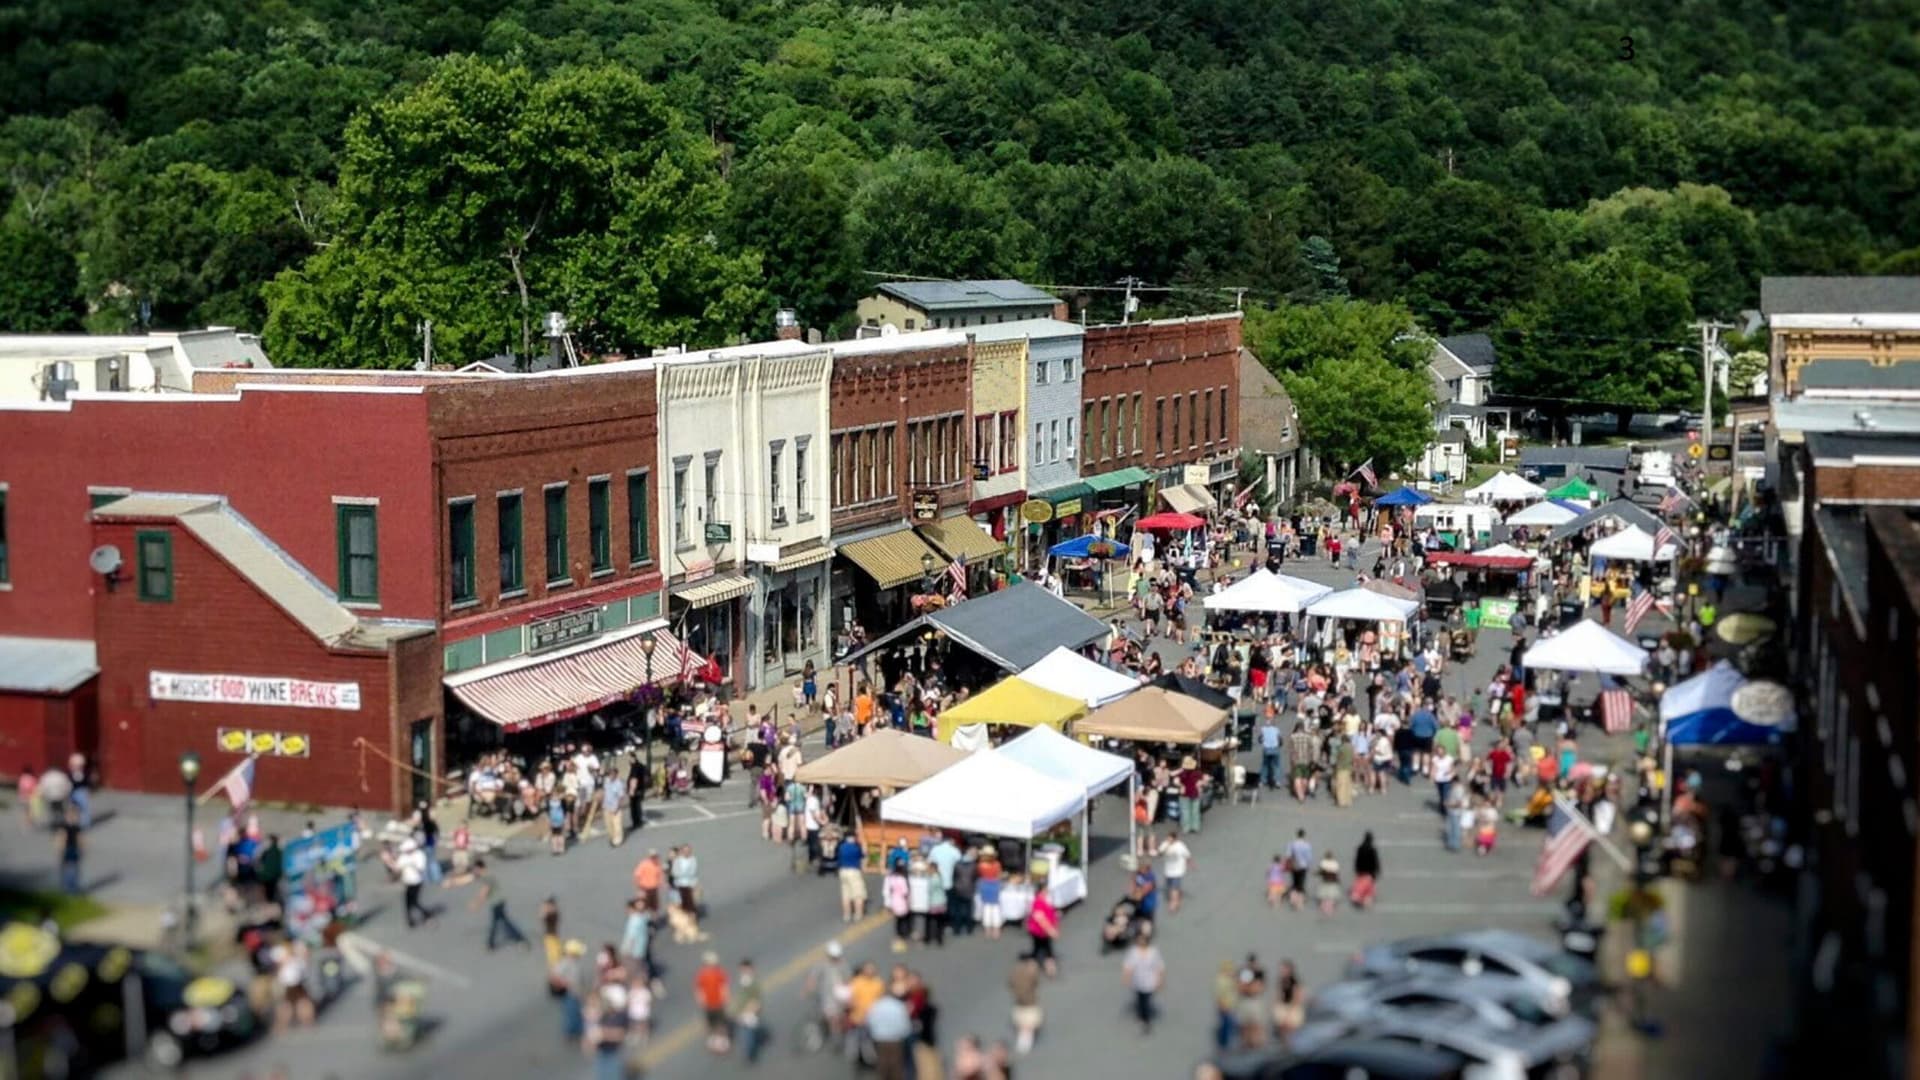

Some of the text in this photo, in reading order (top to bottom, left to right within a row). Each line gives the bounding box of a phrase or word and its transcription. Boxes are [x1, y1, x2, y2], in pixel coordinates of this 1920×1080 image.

[170, 677, 210, 697] MUSIC
[212, 678, 246, 698] FOOD
[248, 681, 288, 701] WINE
[290, 682, 337, 705] BREWS
